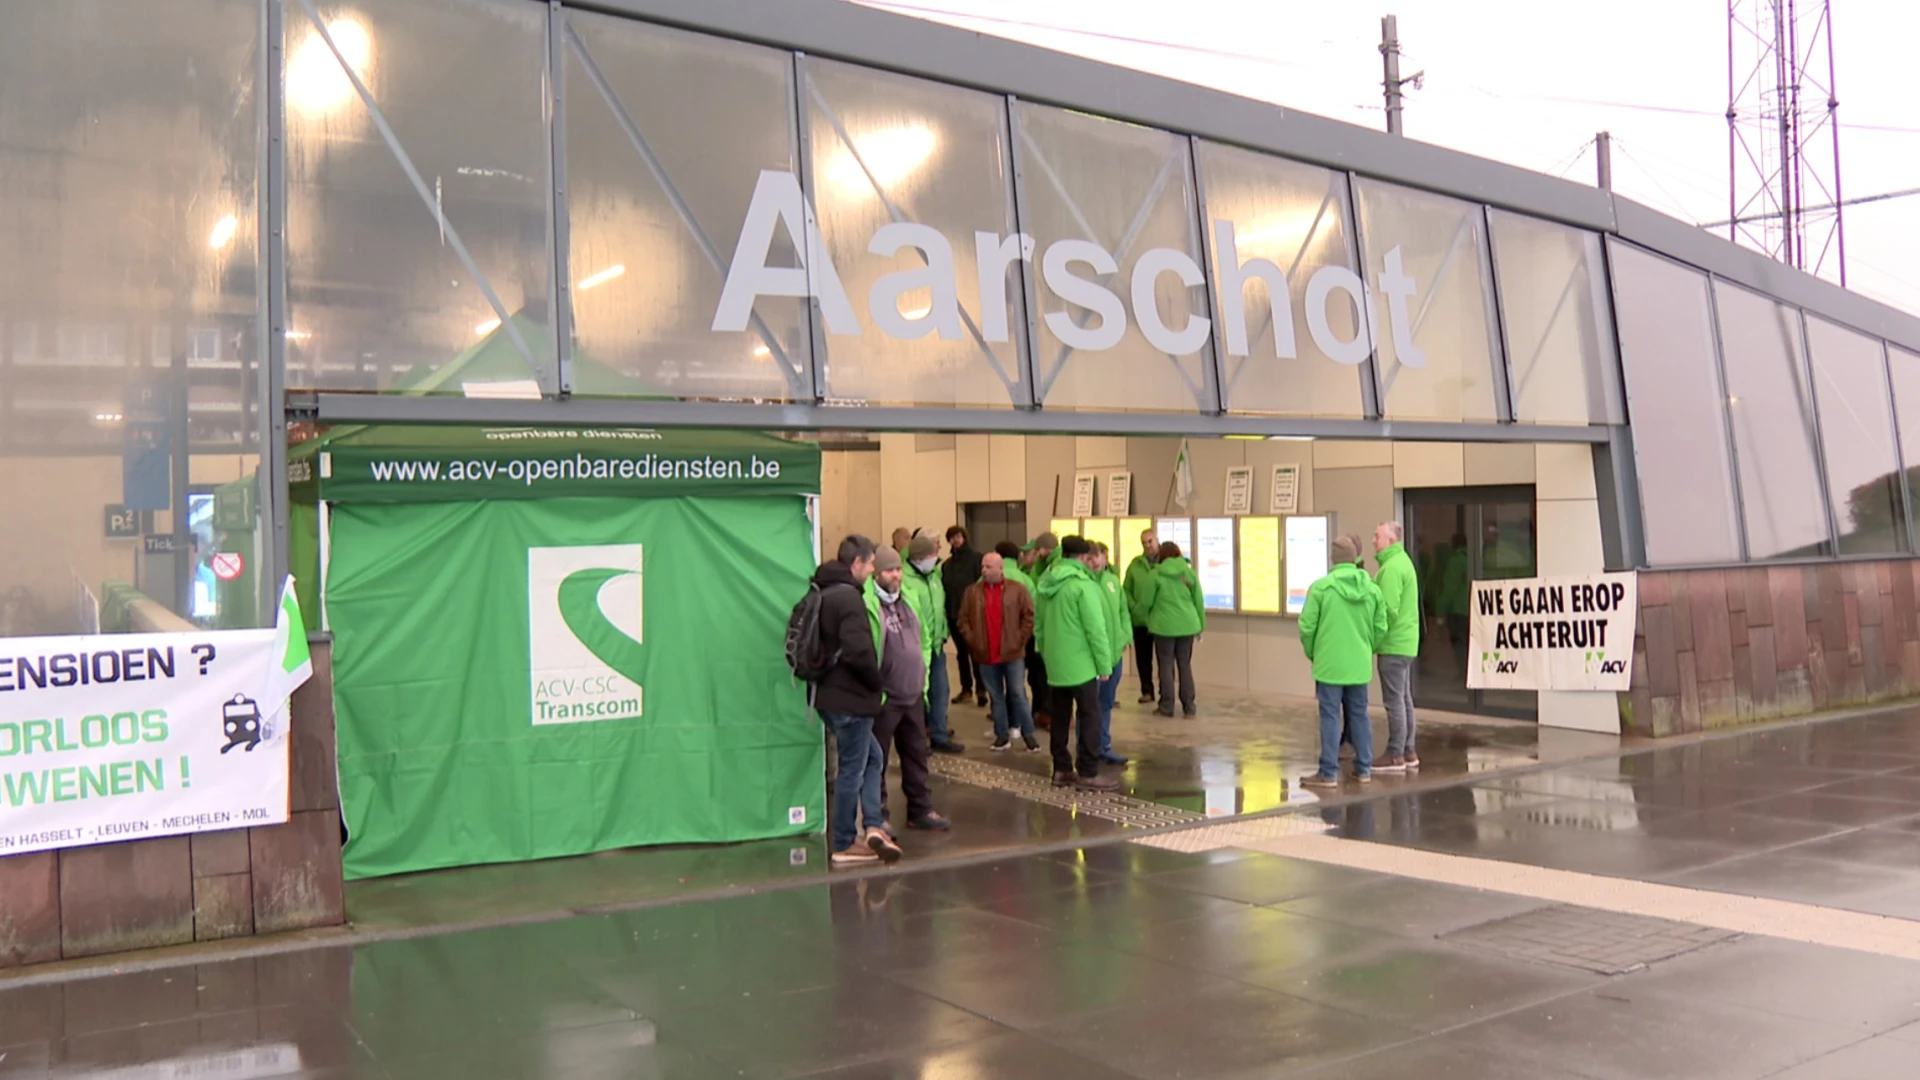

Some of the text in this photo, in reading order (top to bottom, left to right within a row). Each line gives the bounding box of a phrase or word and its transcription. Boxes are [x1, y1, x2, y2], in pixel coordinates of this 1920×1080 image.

[711, 169, 1427, 368] Aarschot
[486, 429, 662, 440] openbare diensten
[371, 453, 780, 486] www.acv-openbarediensten.be
[1478, 582, 1625, 616] WE GAAN EROP
[1495, 619, 1608, 649] ACHTERUIT
[191, 643, 216, 675] ?
[1496, 661, 1519, 674] ACV
[1600, 660, 1627, 674] ACV
[536, 676, 618, 698] ACV-CSC
[536, 698, 639, 719] Transcom
[0, 756, 191, 807] WENEN !
[19, 828, 83, 845] HASSELT
[98, 820, 149, 836] LEUVEN
[162, 812, 230, 830] MECHELEN
[243, 808, 270, 820] MOL
